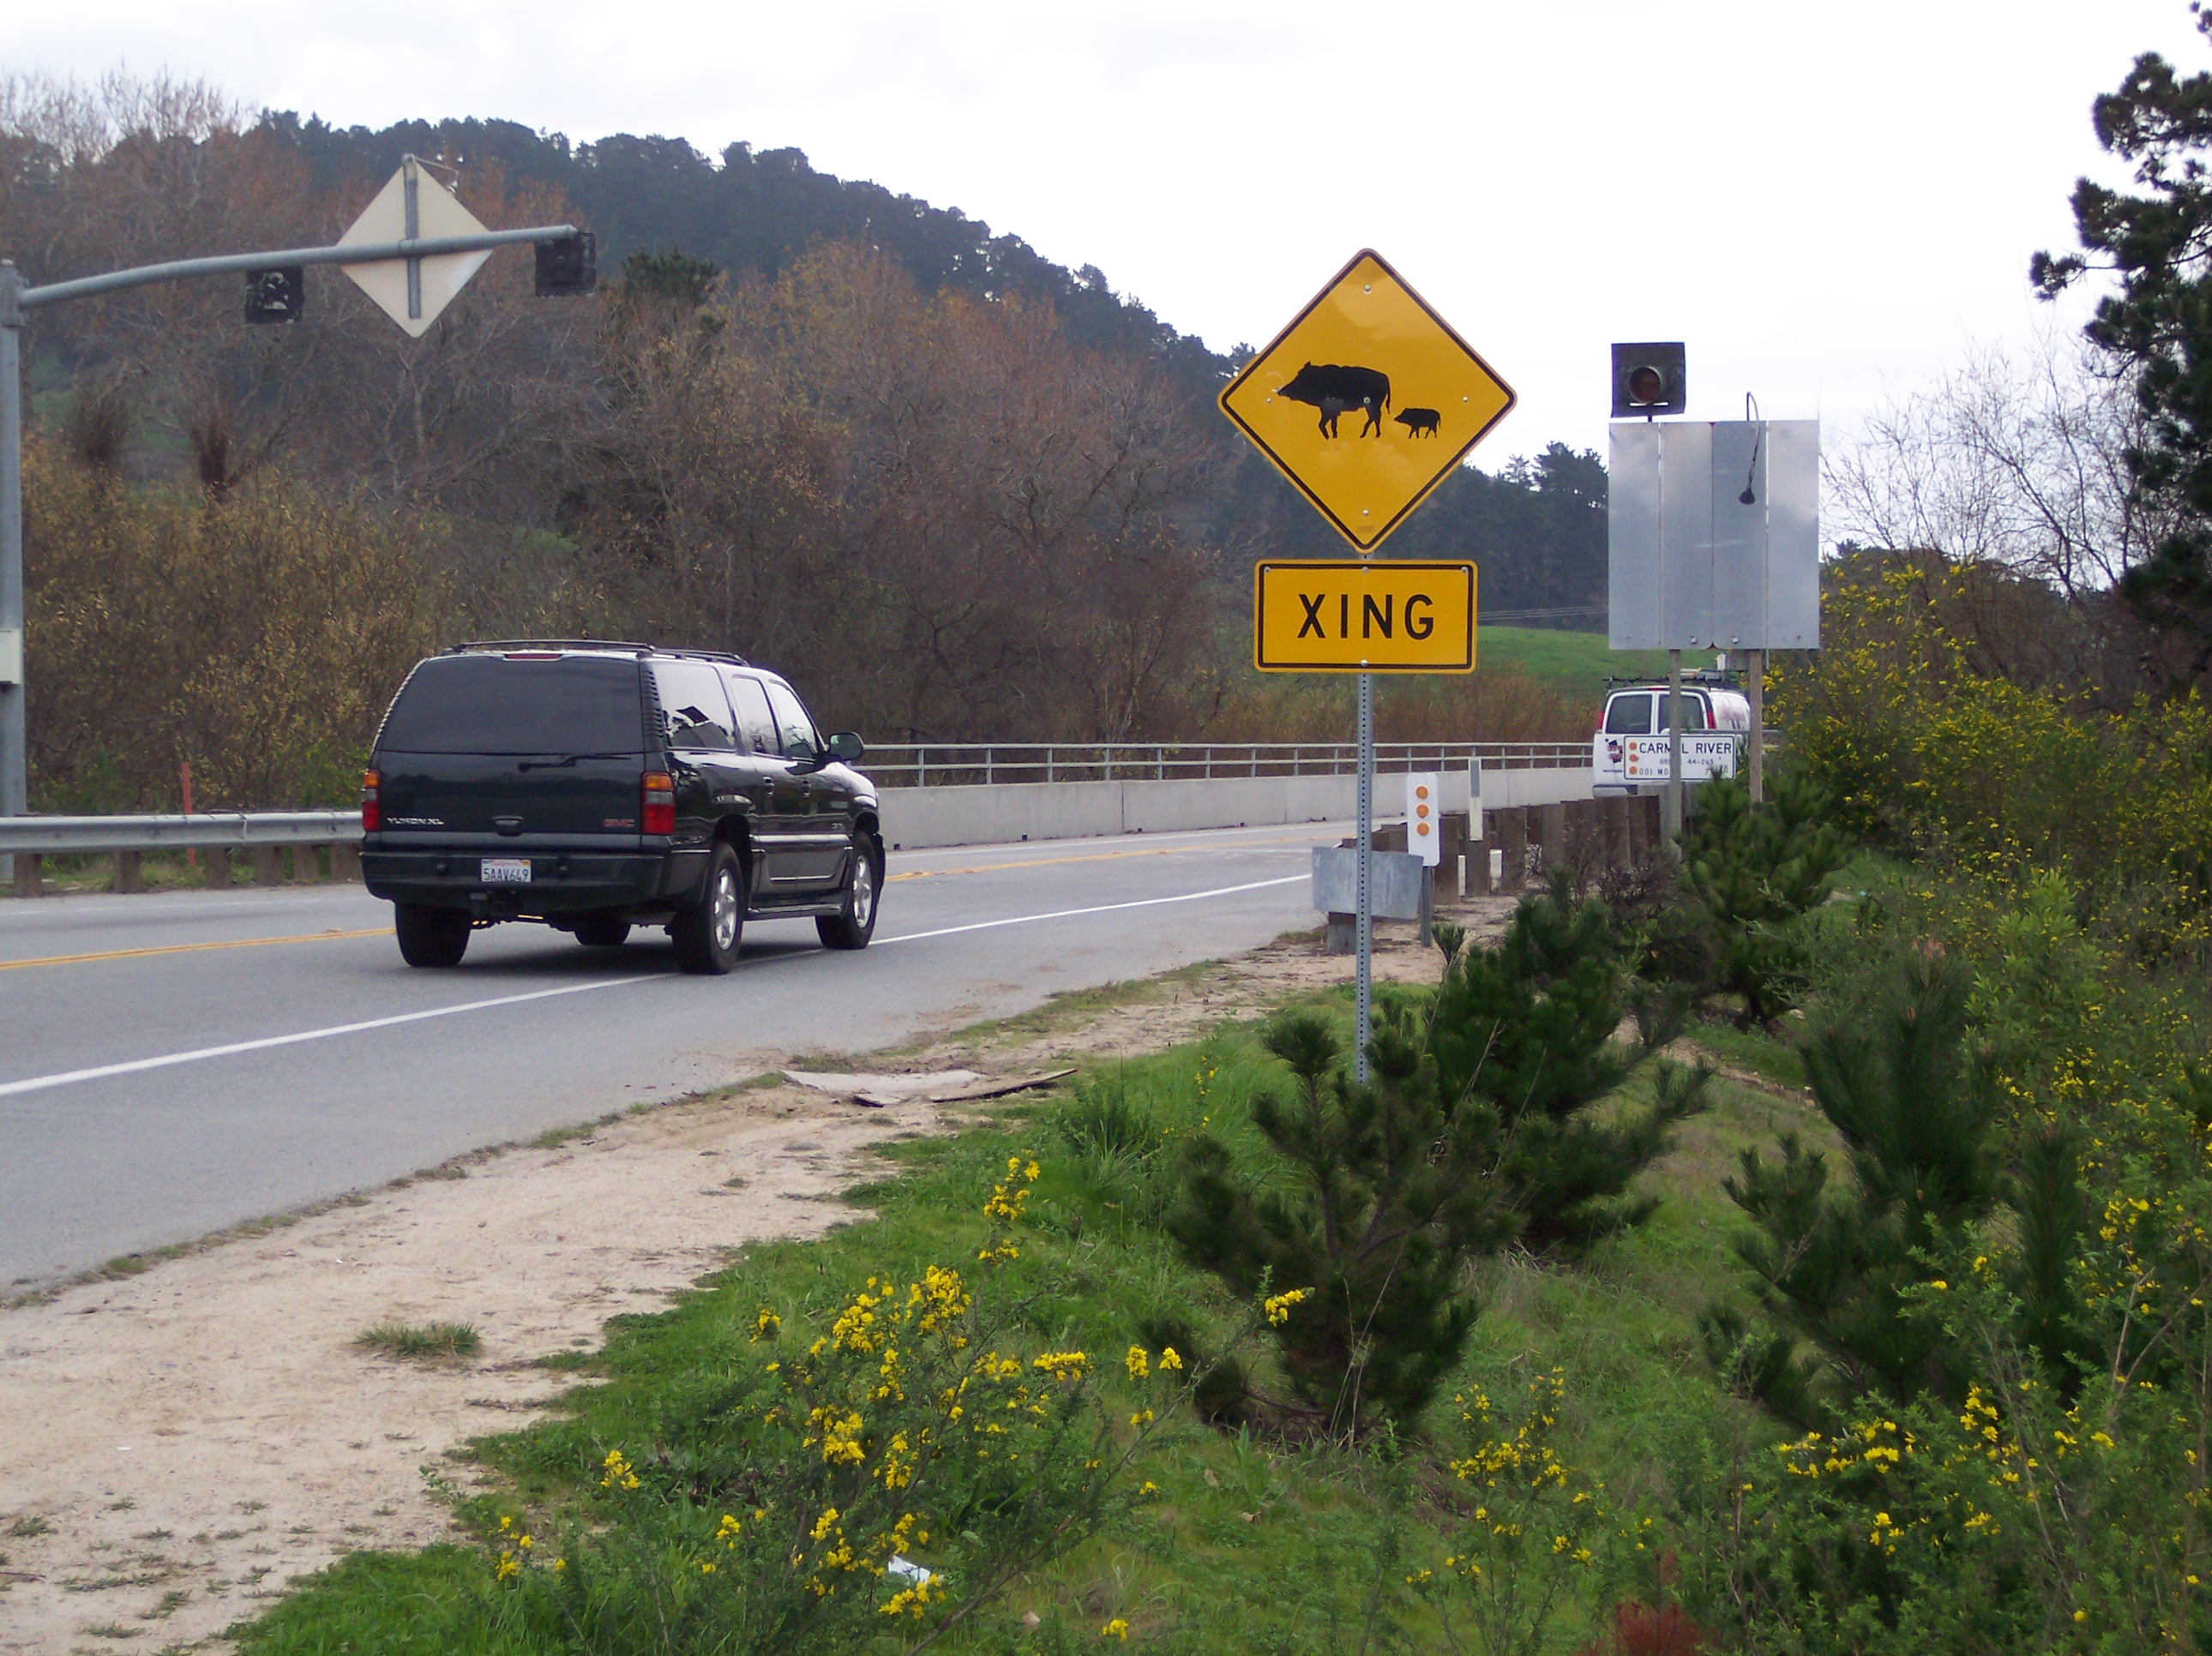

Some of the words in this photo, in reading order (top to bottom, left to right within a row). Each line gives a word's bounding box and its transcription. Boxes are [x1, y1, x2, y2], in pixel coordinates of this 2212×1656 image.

[1297, 594, 1434, 640] XING
[1638, 742, 1689, 754] CARML
[1695, 742, 1732, 754] RIVER
